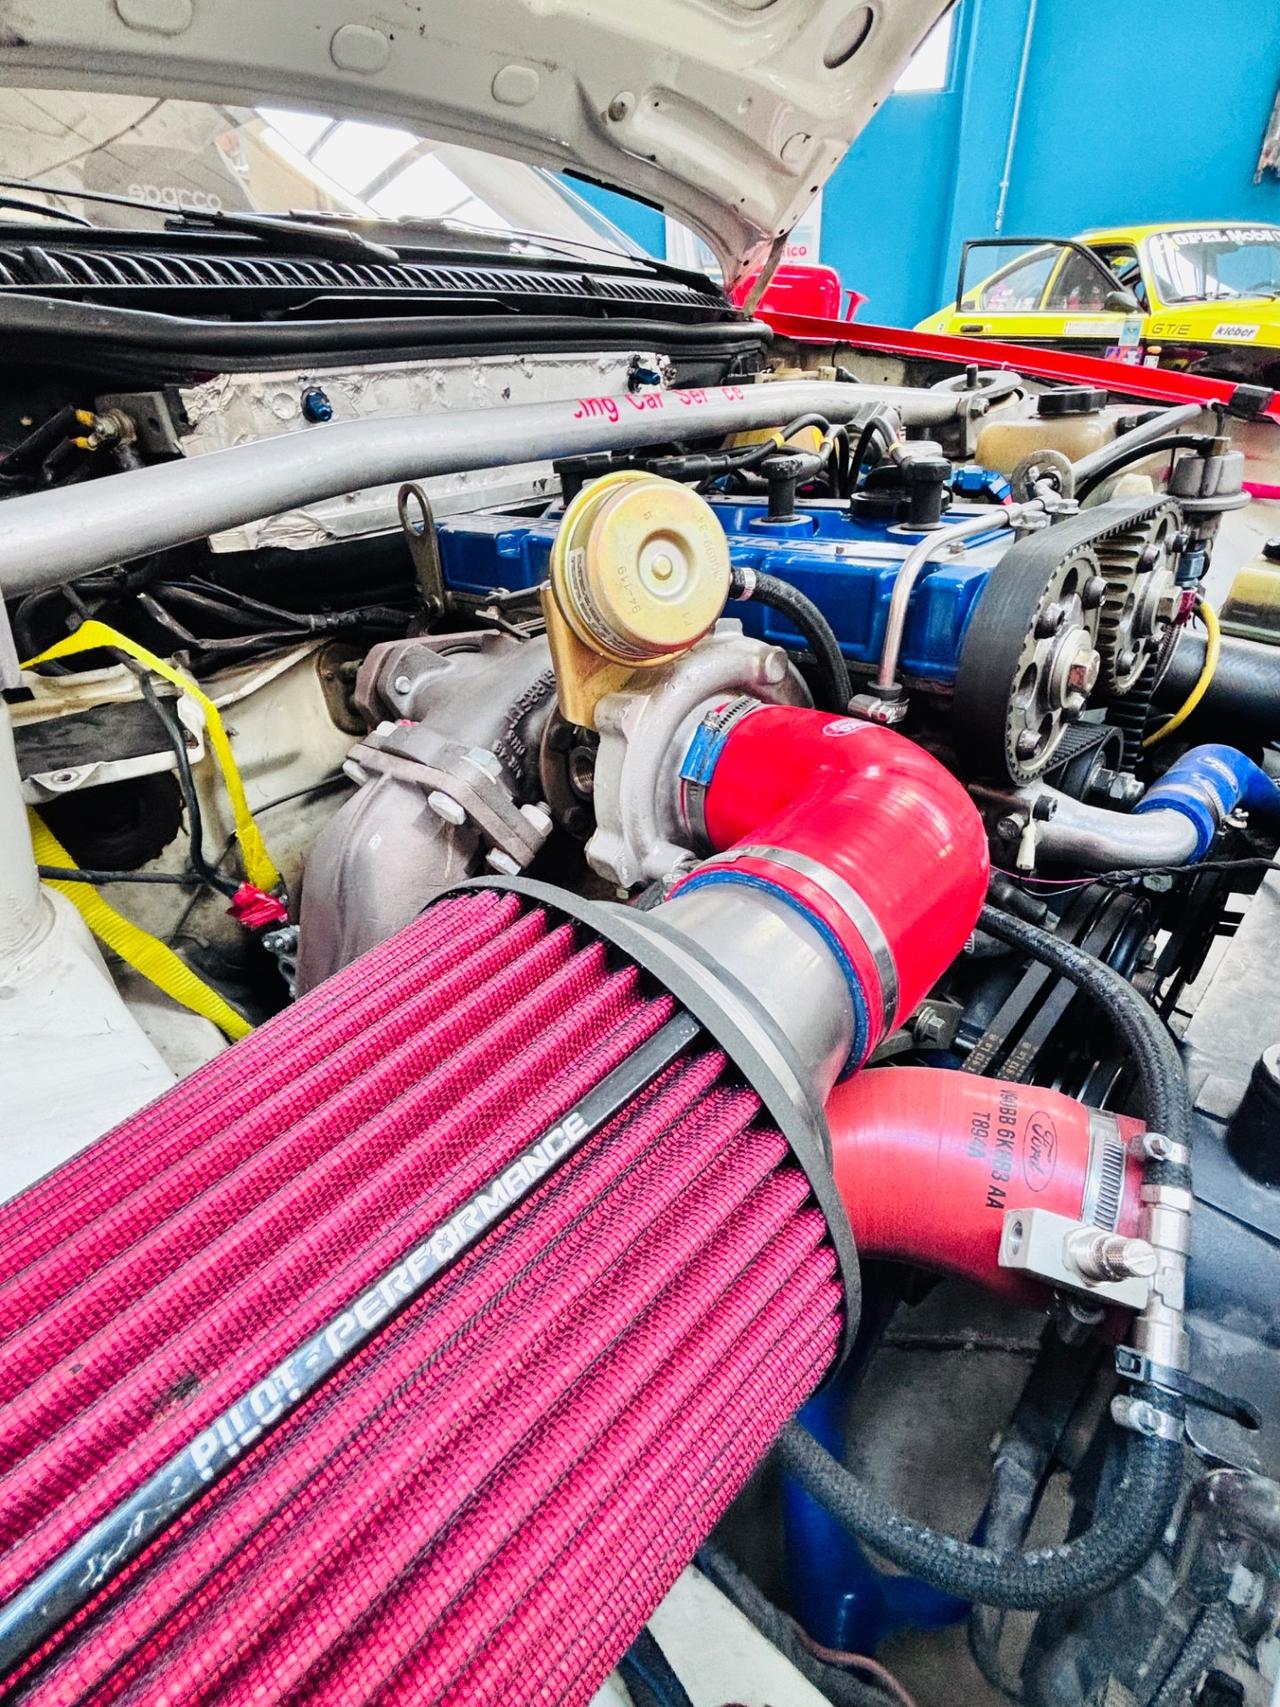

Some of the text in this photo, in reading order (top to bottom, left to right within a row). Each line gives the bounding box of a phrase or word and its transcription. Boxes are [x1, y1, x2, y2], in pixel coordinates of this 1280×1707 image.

[625, 392, 664, 410] Car
[1028, 1123, 1055, 1176] Ford
[985, 1184, 1007, 1209] AA
[324, 1112, 590, 1358] PERFORMANCE
